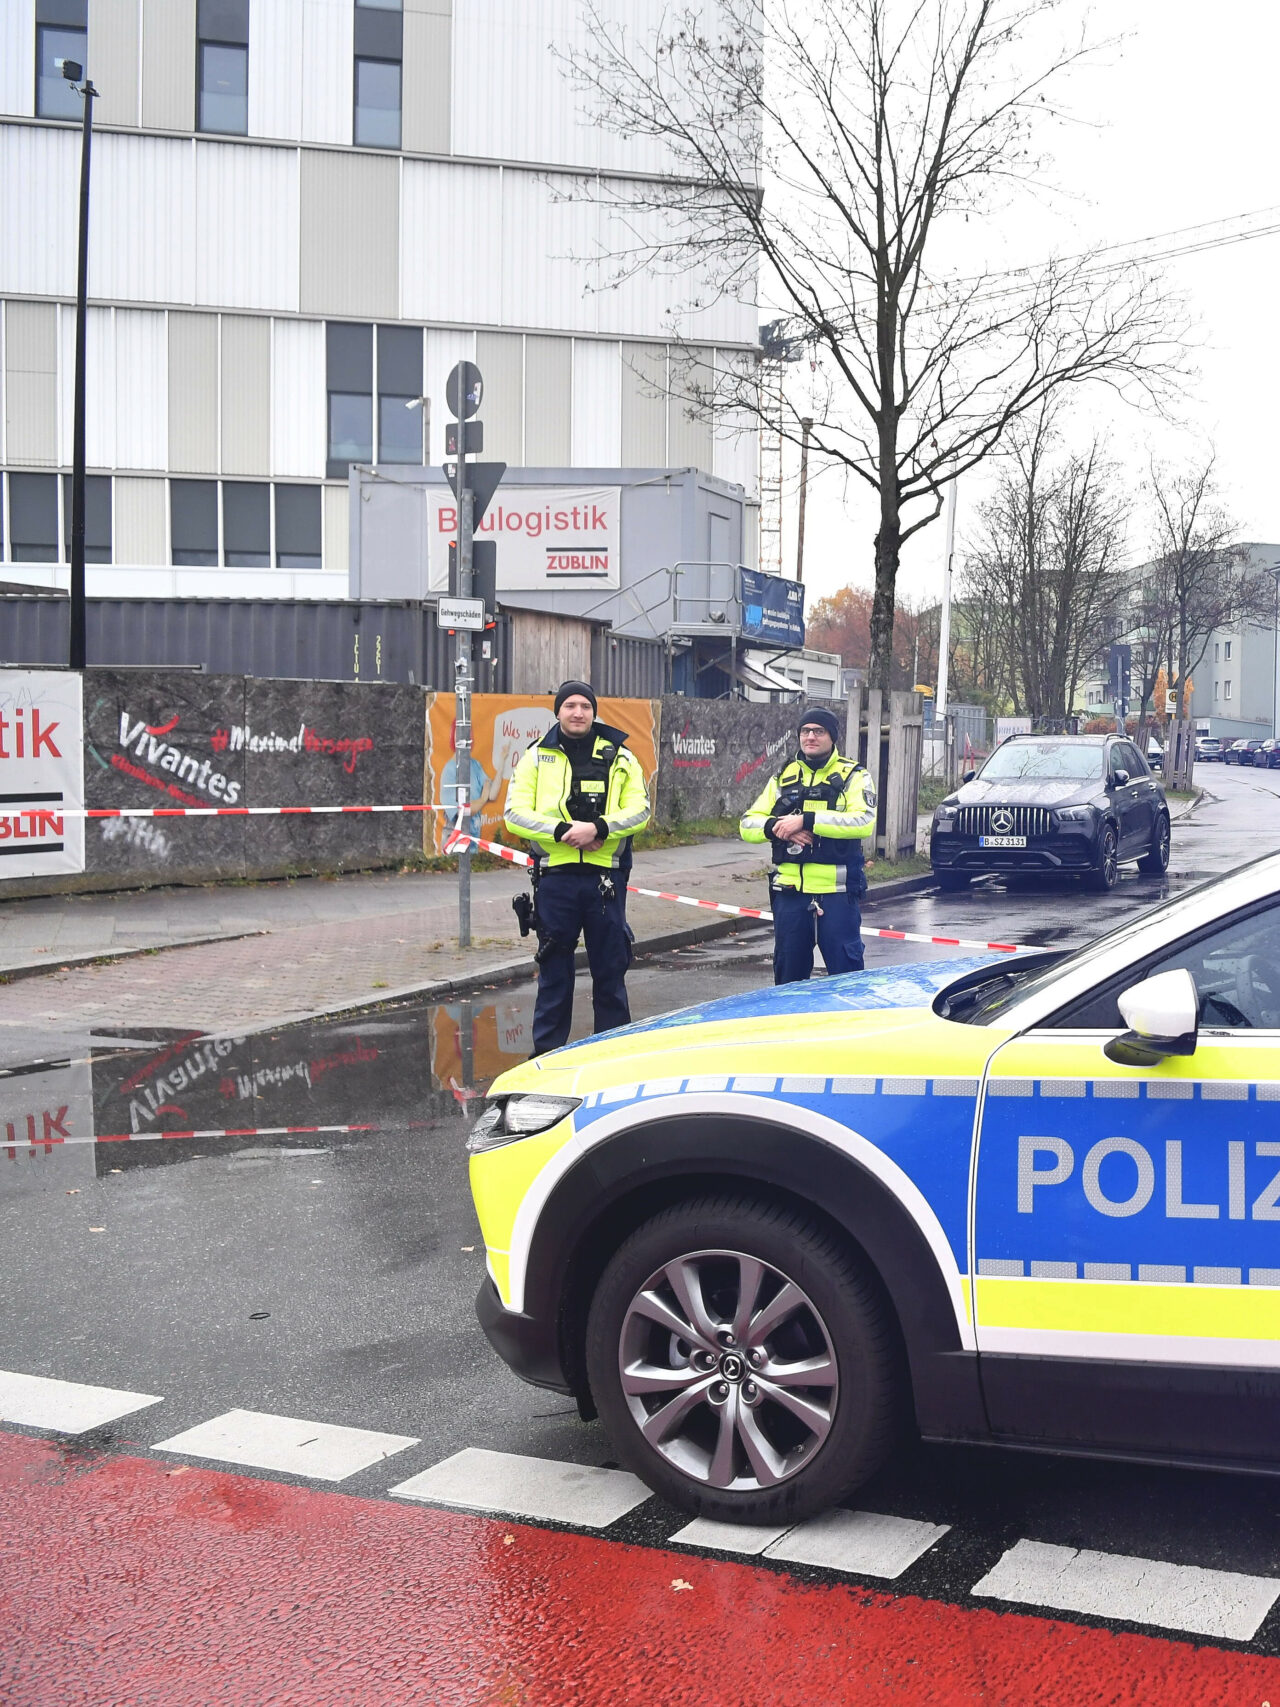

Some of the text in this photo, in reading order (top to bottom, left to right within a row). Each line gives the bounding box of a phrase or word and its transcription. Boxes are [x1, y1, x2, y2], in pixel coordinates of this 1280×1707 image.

[438, 505, 608, 537] Bulogistik
[546, 555, 608, 570] ZÜBLIN
[441, 607, 482, 619] Gehwegschäden
[673, 731, 716, 755] Vivantes
[119, 712, 241, 804] Vivantes
[984, 838, 1025, 846] B SZ 3131
